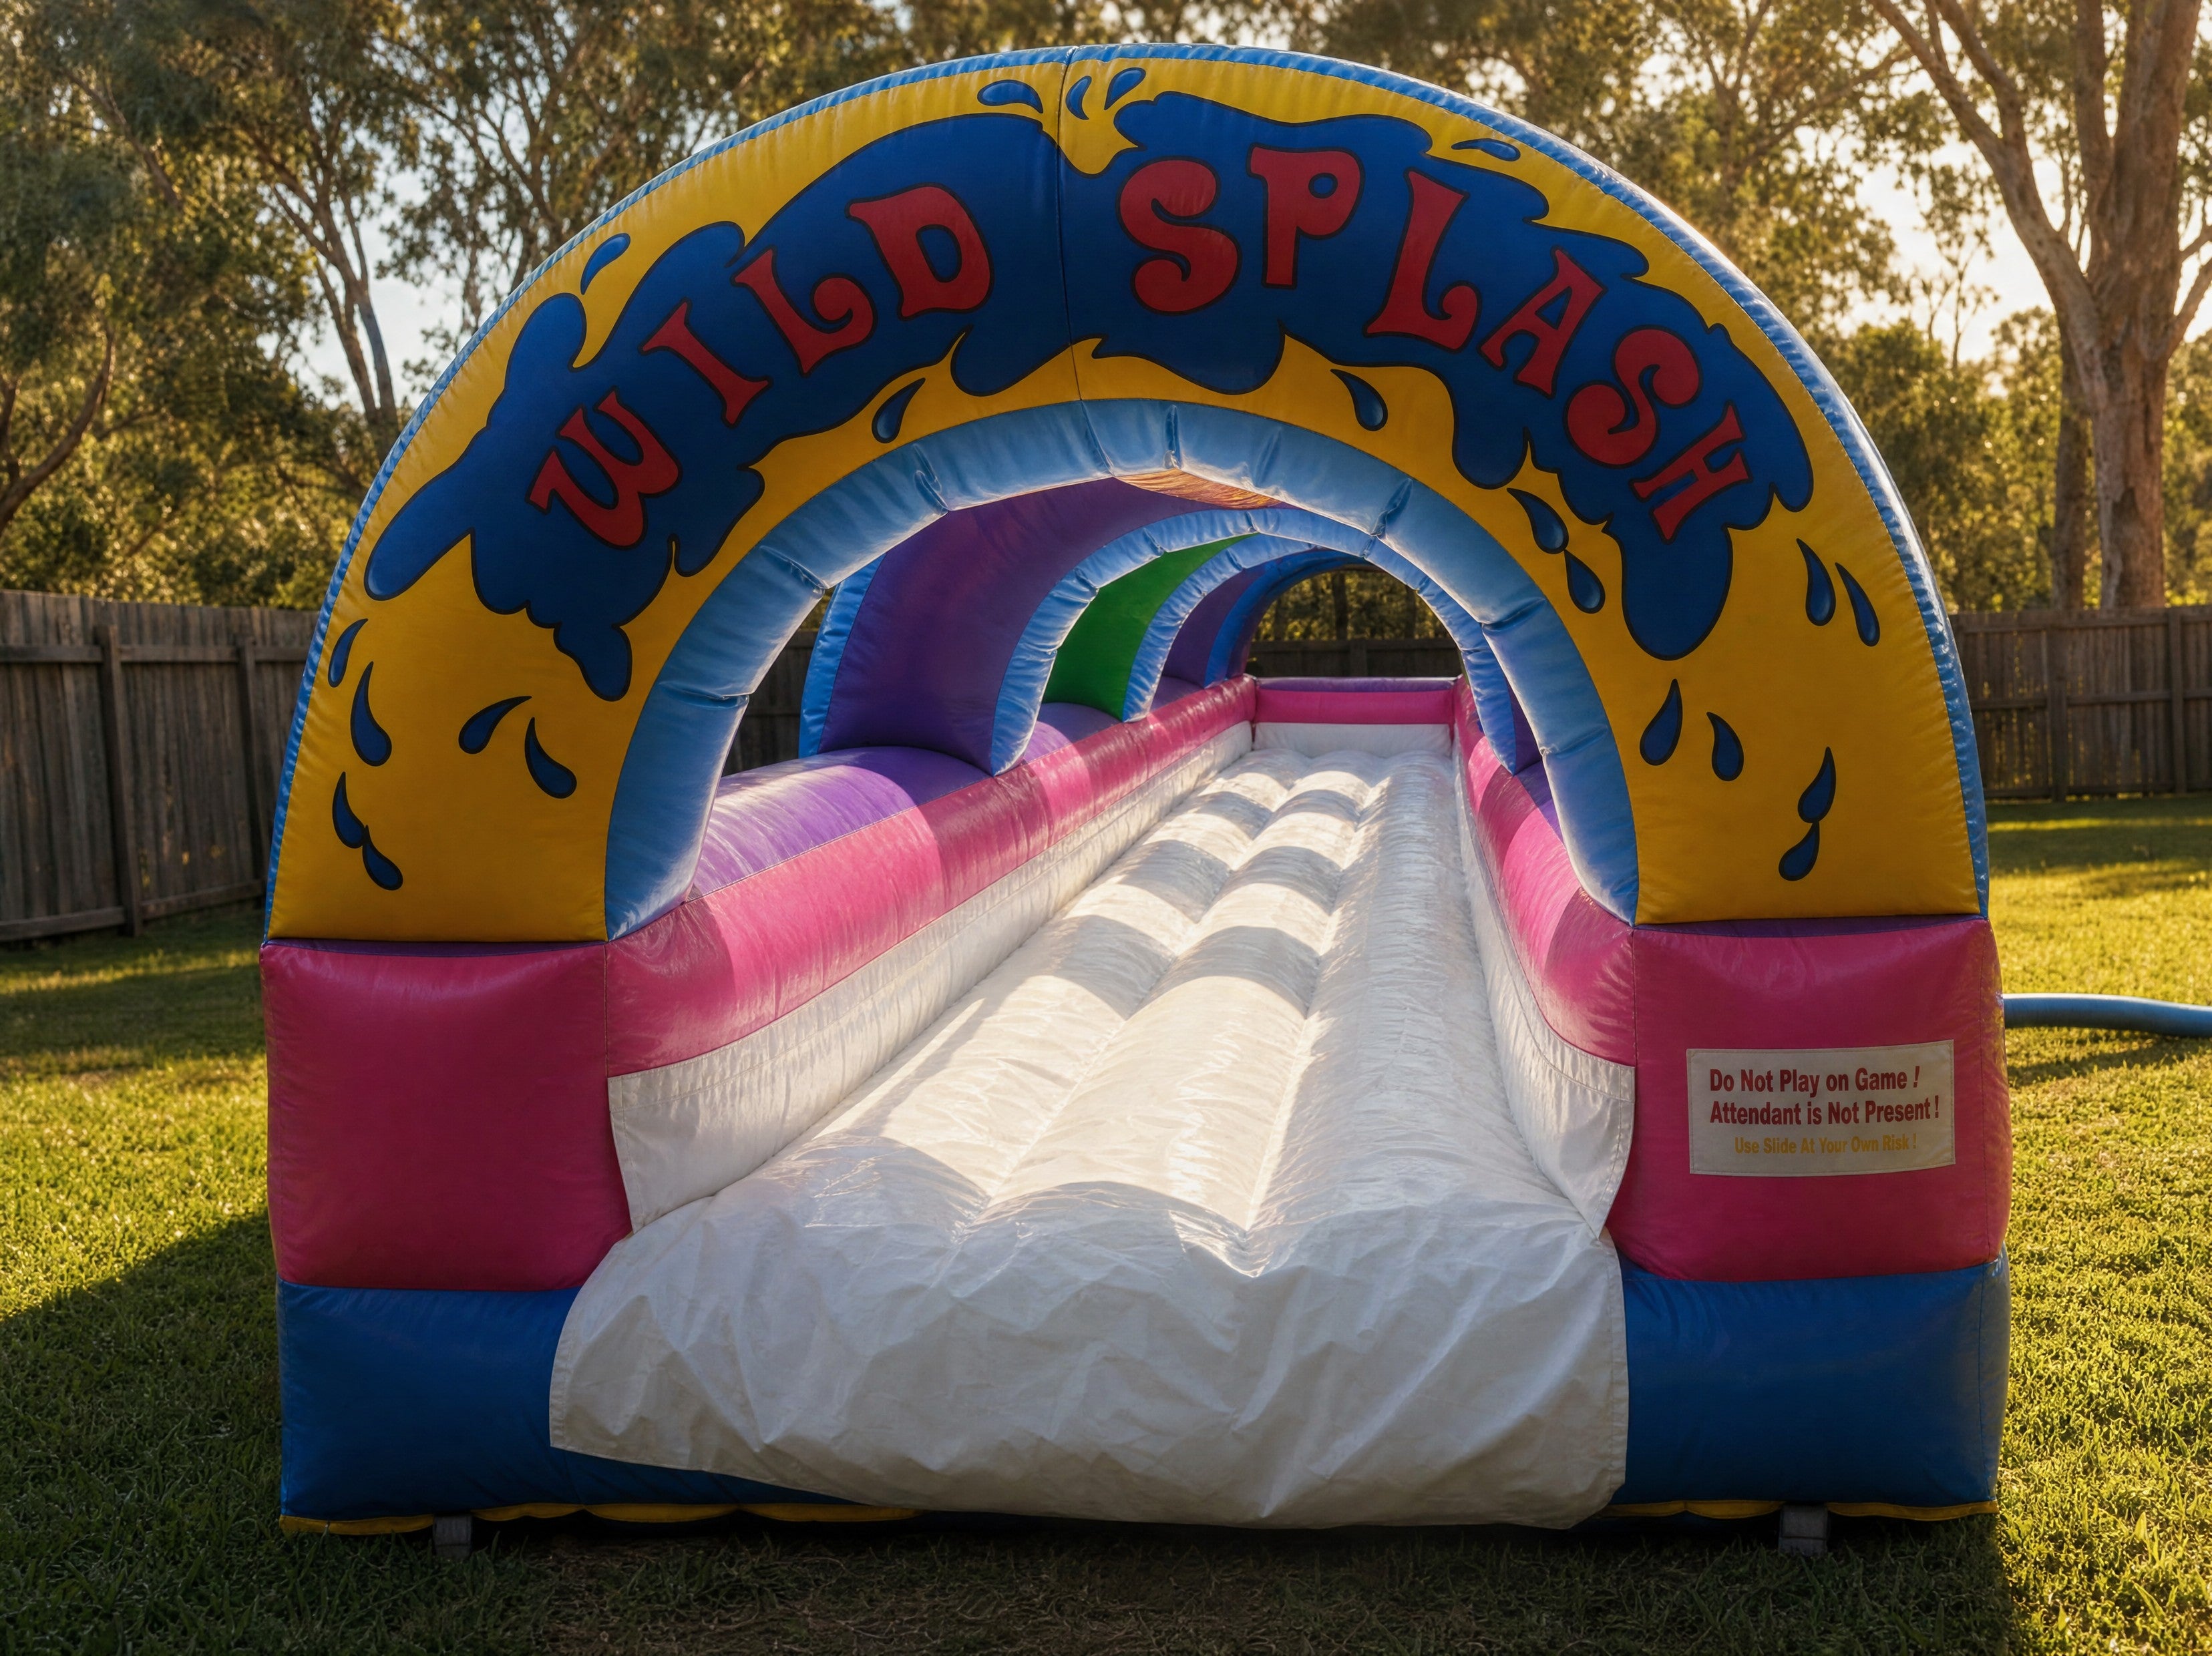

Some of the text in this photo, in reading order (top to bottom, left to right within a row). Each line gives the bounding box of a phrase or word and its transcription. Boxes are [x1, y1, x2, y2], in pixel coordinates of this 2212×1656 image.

[526, 143, 1751, 549] WILD SPLASH
[1710, 1066, 1920, 1098] Do Not Play on Game !
[1710, 1101, 1801, 1125] Attendant
[1807, 1100, 1823, 1125] is
[1828, 1101, 1859, 1124] Not
[1865, 1097, 1931, 1123] Present
[1734, 1137, 1760, 1154] Use
[1763, 1137, 1797, 1154] Slide
[1801, 1137, 1815, 1153] At
[1819, 1136, 1847, 1153] Your
[1851, 1136, 1879, 1152] Own
[1882, 1133, 1909, 1151] Risk
